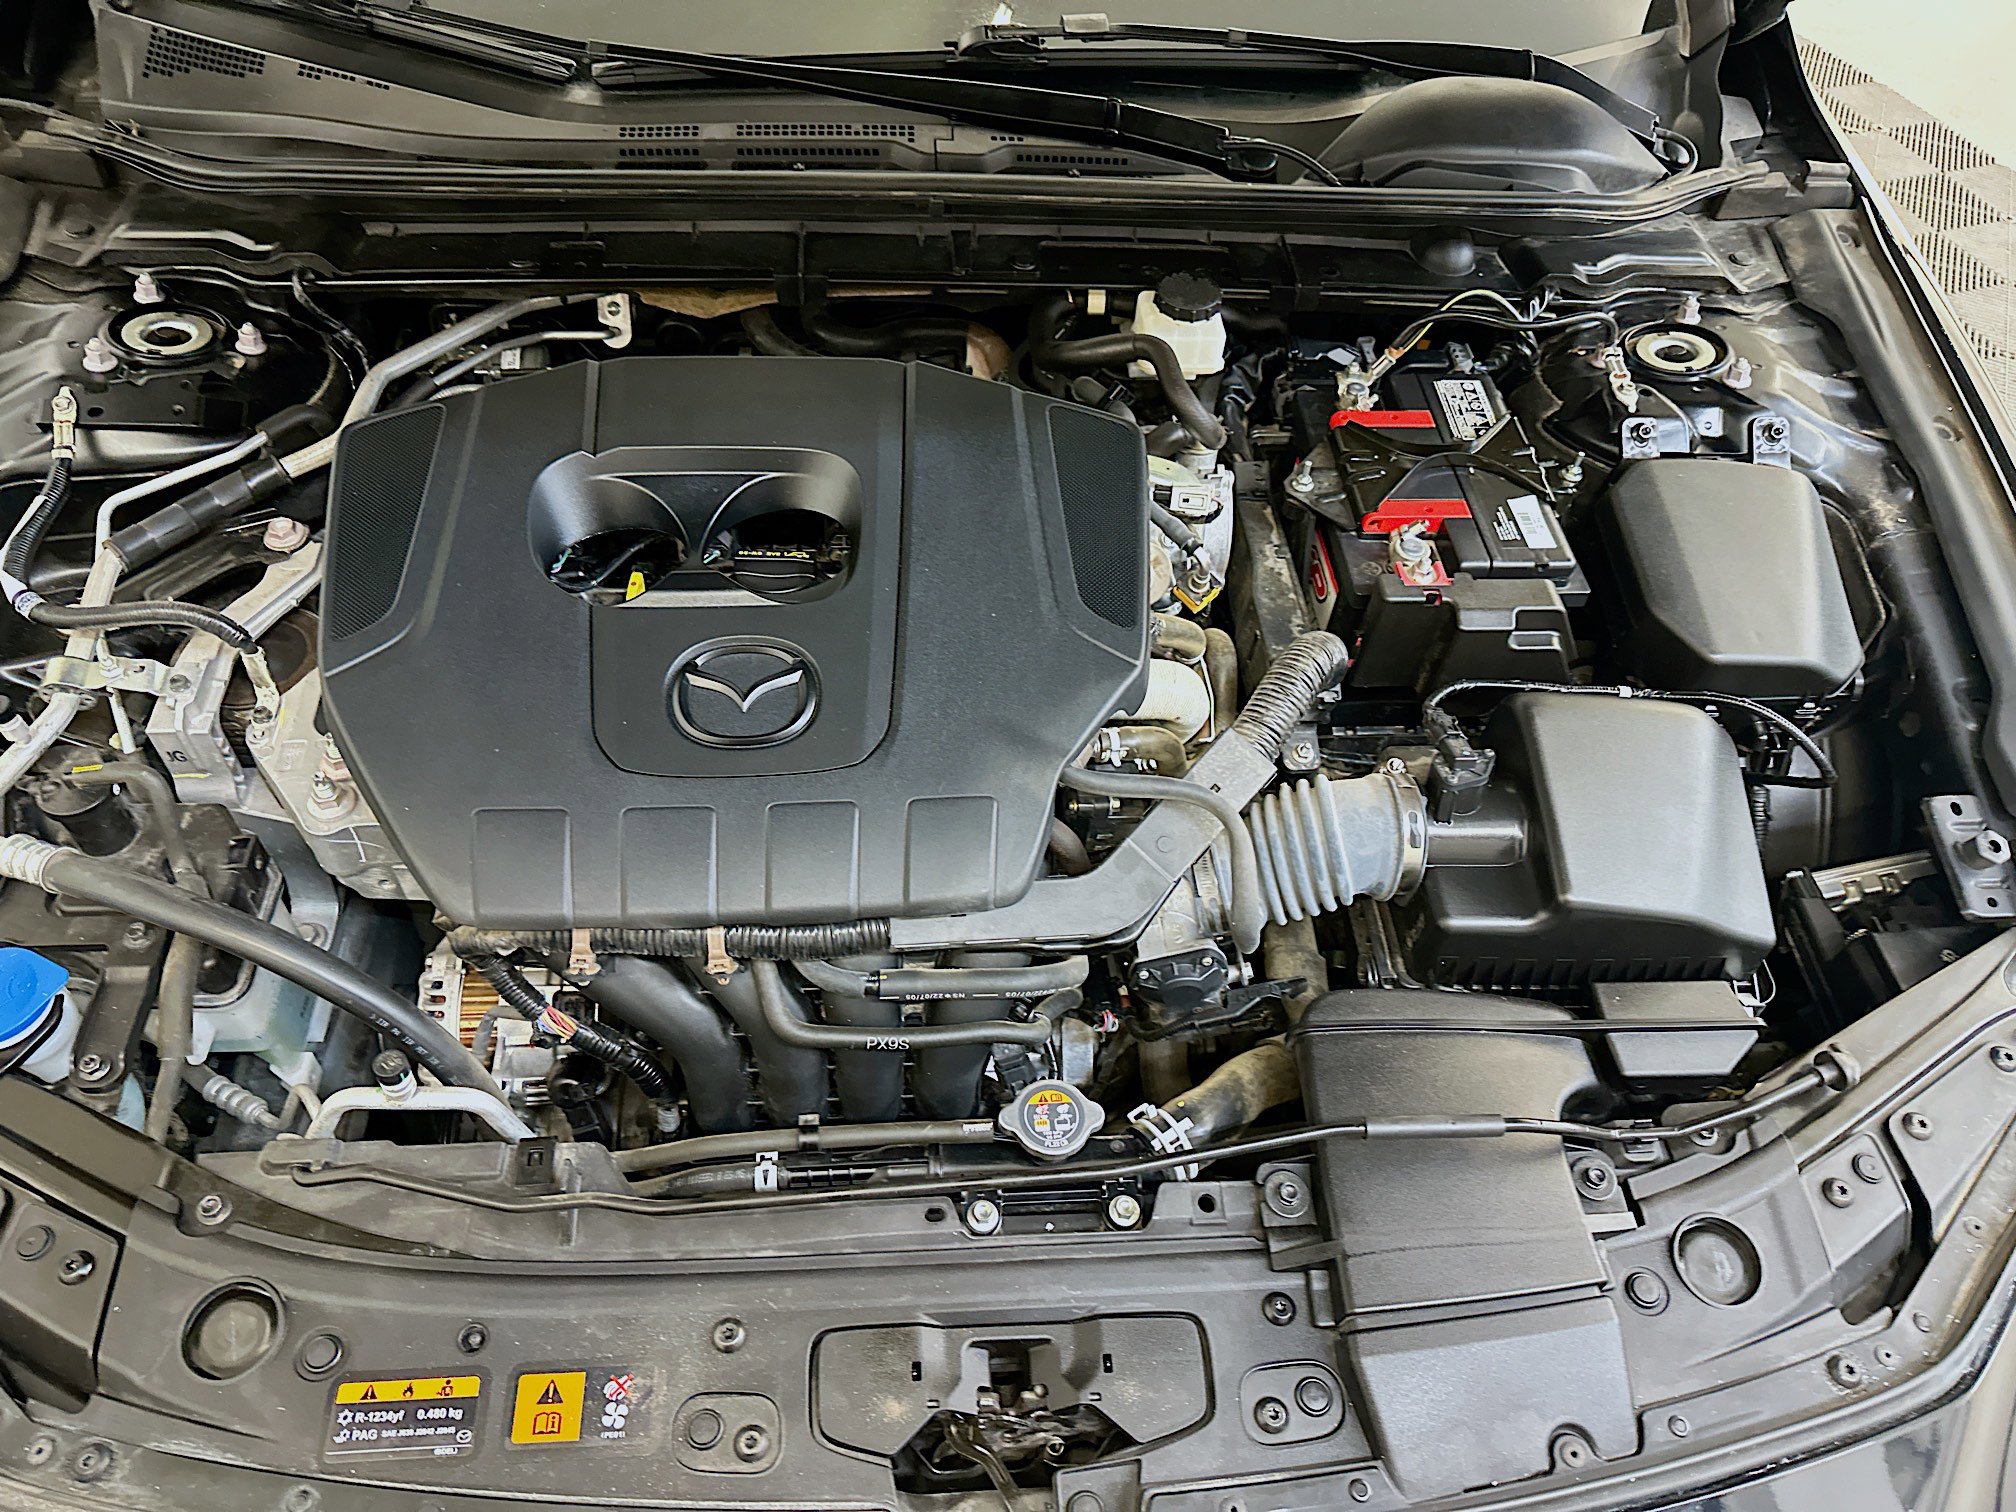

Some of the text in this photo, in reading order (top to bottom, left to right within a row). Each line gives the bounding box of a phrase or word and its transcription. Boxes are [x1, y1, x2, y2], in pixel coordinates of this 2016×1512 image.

[866, 1036, 910, 1050] PX9S
[354, 1407, 464, 1424] R-1234yf 0.480 kg
[351, 1428, 378, 1441] PAG
[381, 1429, 397, 1438] SAE
